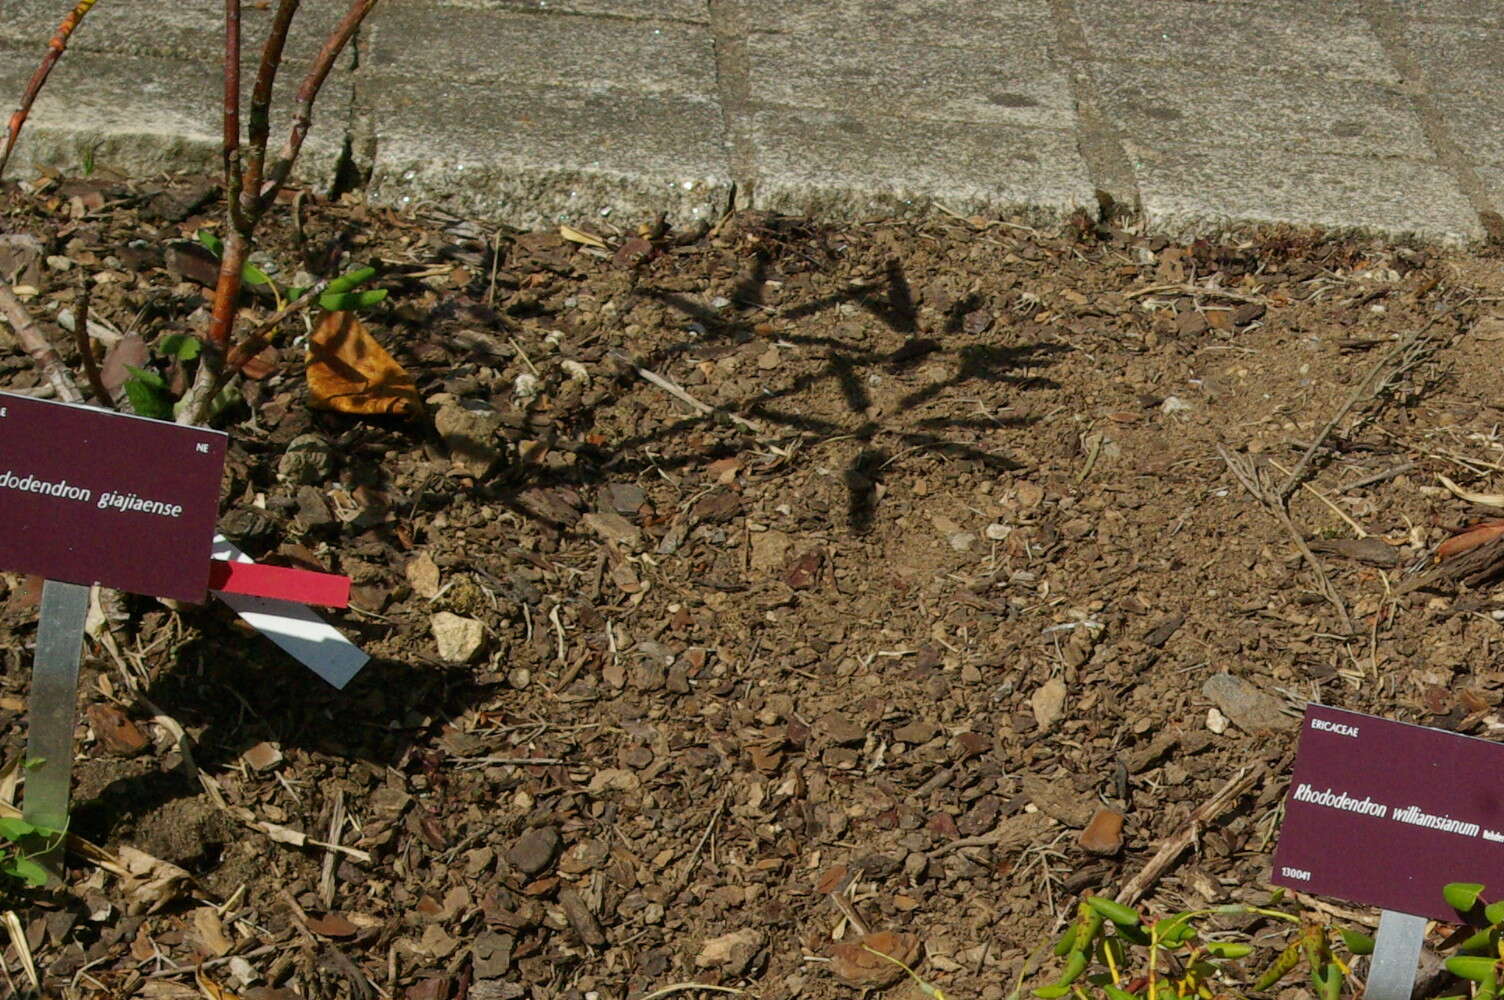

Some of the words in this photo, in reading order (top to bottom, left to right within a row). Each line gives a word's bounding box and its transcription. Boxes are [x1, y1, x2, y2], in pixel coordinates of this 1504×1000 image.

[195, 442, 209, 454] NE
[97, 490, 183, 518] giajiaense
[1311, 718, 1360, 738] ERICACEAE
[1293, 783, 1388, 818] Rhododendron
[1392, 805, 1480, 837] williamsianum
[1281, 867, 1311, 881] 130041
